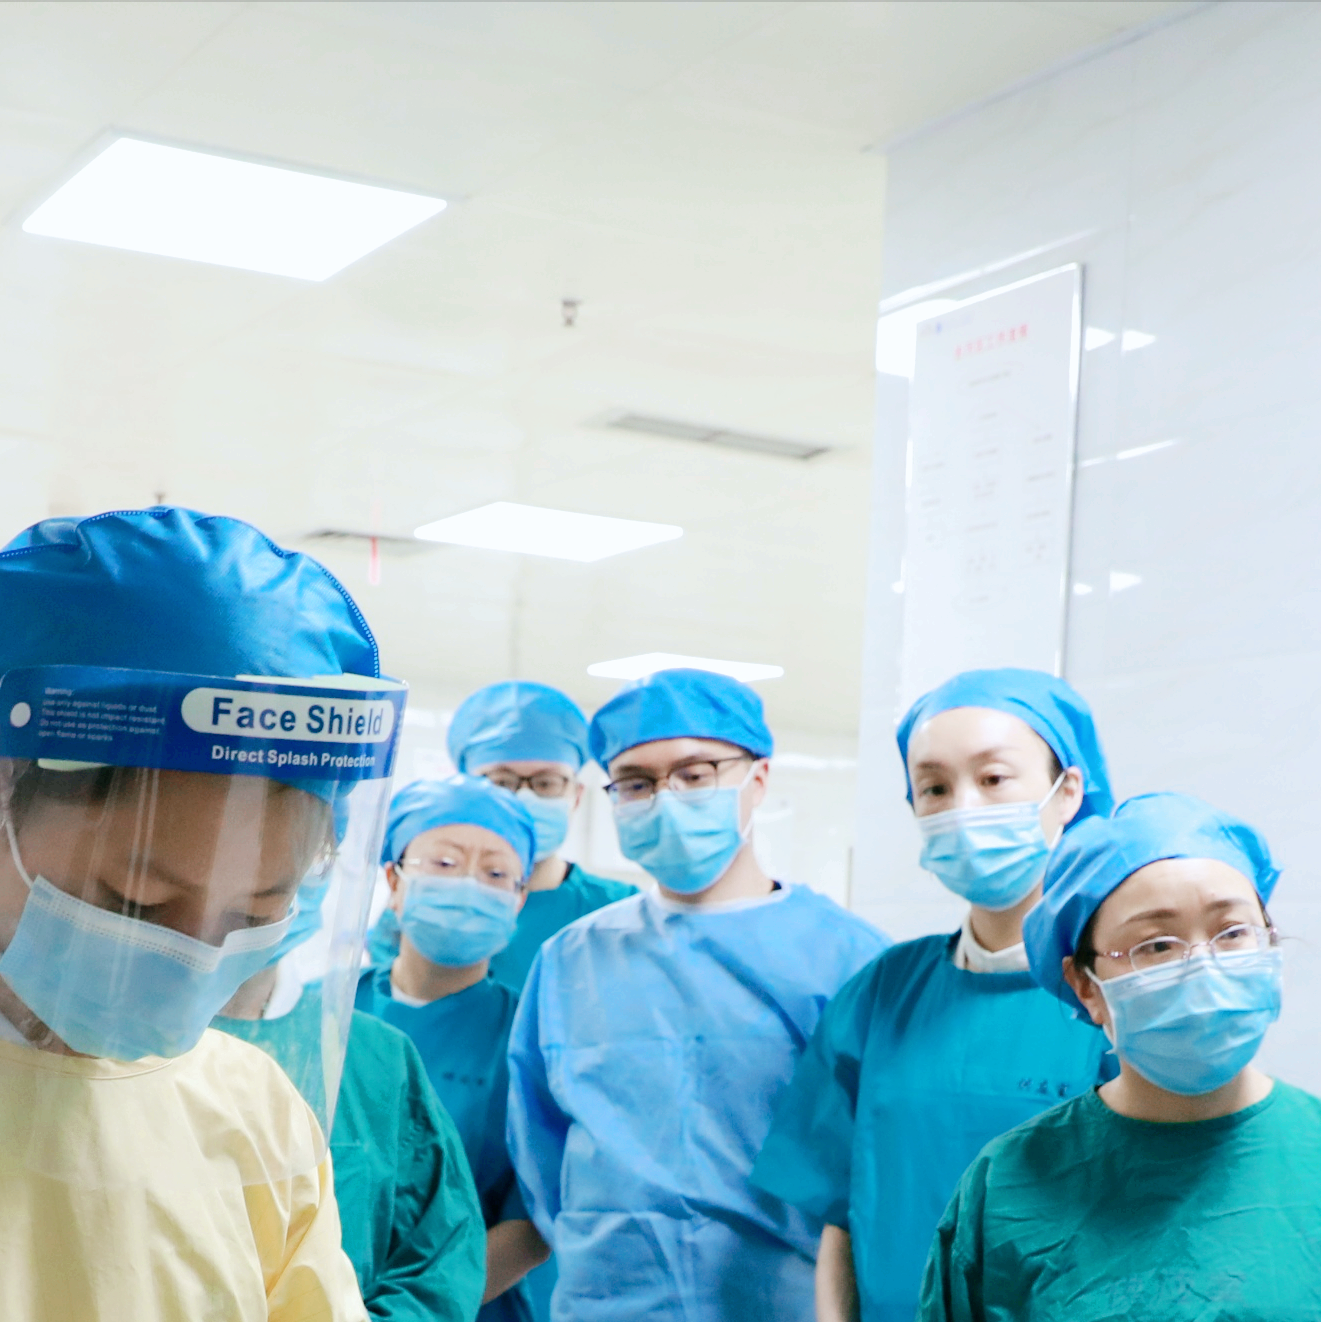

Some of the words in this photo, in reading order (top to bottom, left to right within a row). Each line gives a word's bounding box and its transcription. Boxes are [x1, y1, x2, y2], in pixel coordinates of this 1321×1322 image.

[211, 697, 297, 732] Face
[306, 705, 384, 736] Shield
[211, 745, 265, 763] Direct
[267, 749, 318, 767] Splash
[320, 754, 376, 769] Protection
